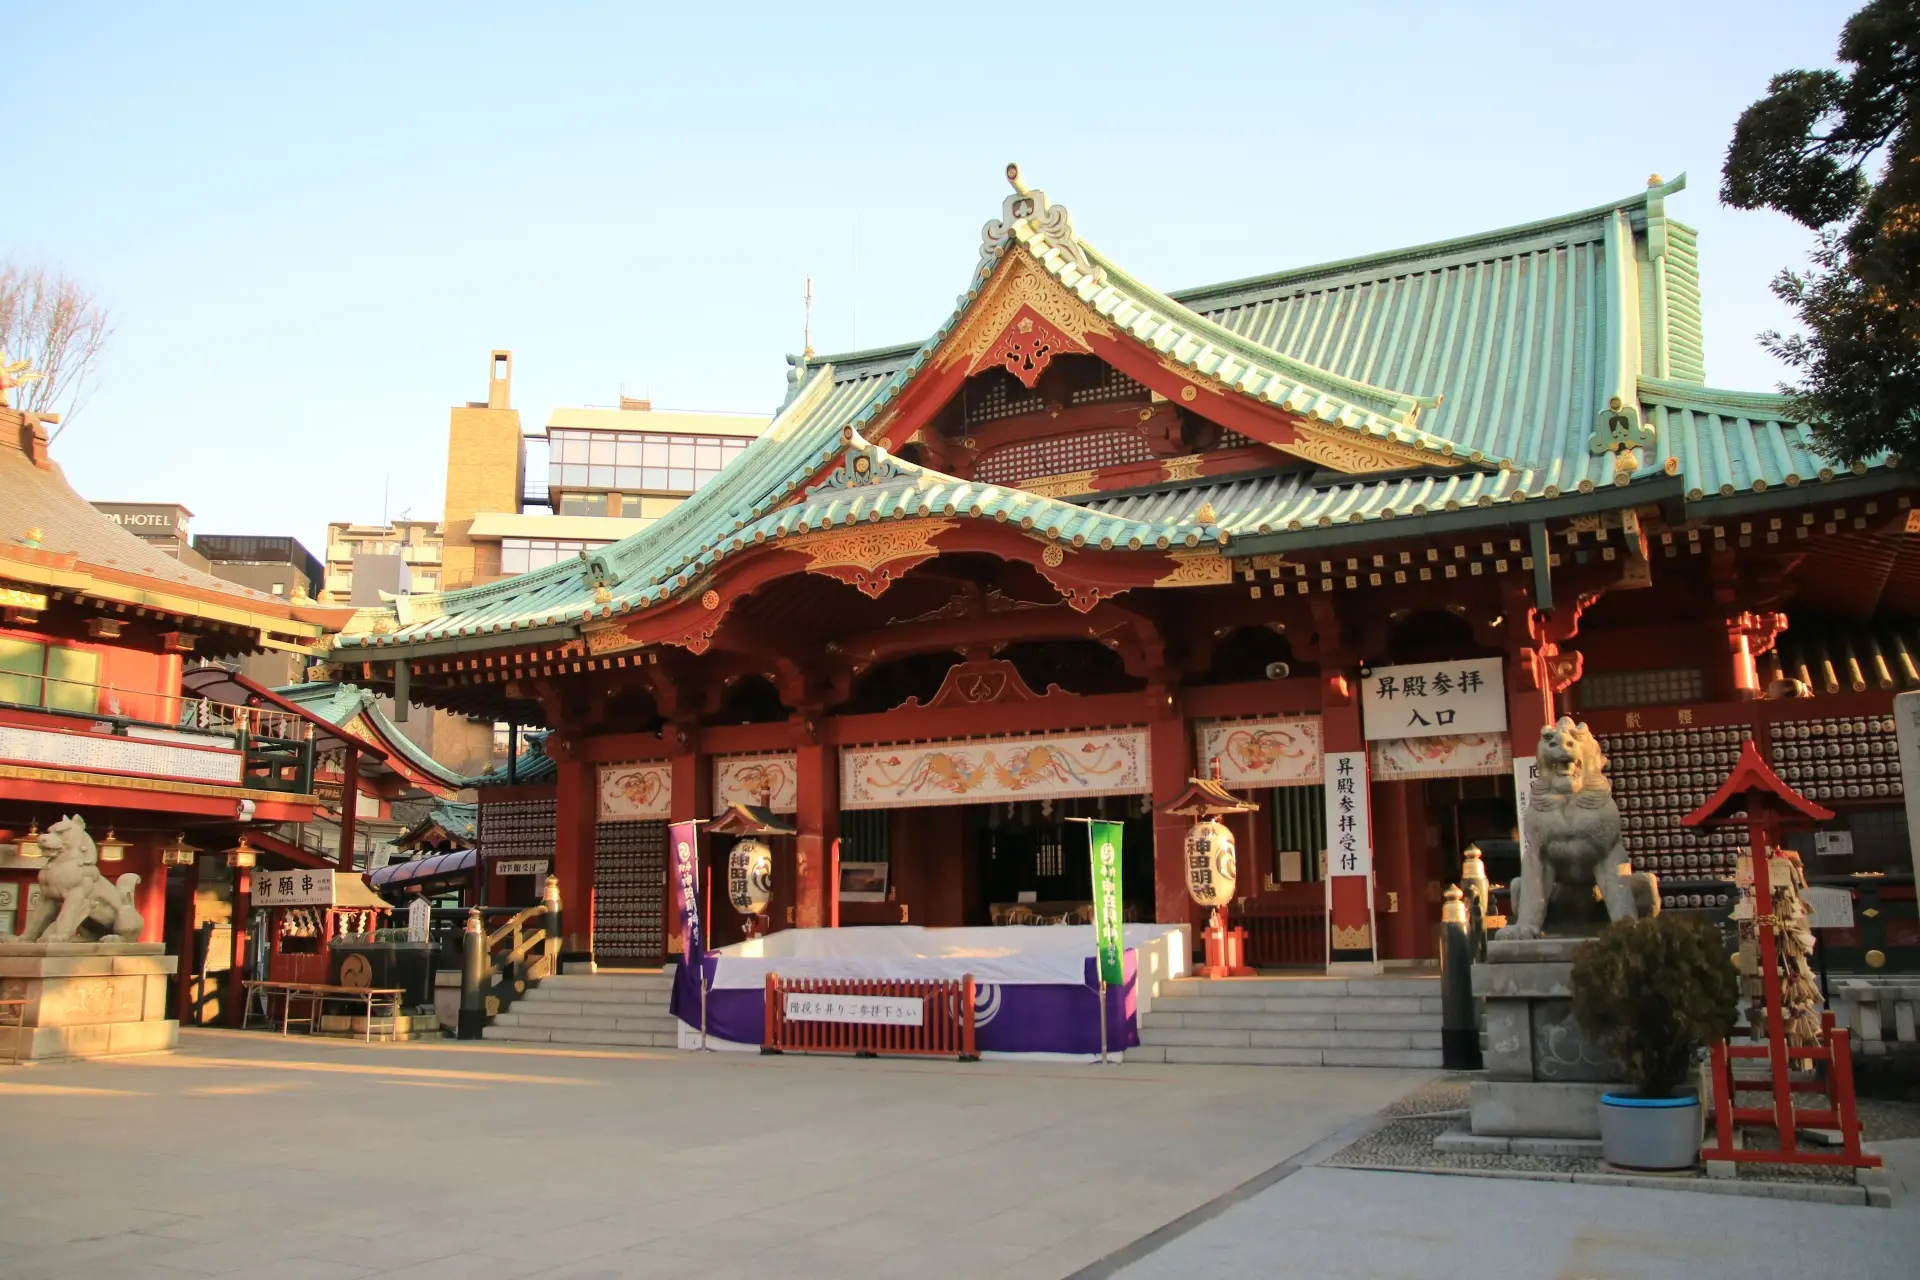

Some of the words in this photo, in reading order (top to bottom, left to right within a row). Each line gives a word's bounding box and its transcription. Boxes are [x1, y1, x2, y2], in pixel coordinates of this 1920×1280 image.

[124, 514, 171, 525] HOTEL
[1376, 670, 1484, 700] 昇殿参拝
[1406, 708, 1456, 727] 入口
[1337, 757, 1358, 871] 昇殿参拝受付
[730, 852, 752, 908] 神田明神
[1187, 838, 1216, 900] 神田明神
[257, 874, 314, 897] 祈願串
